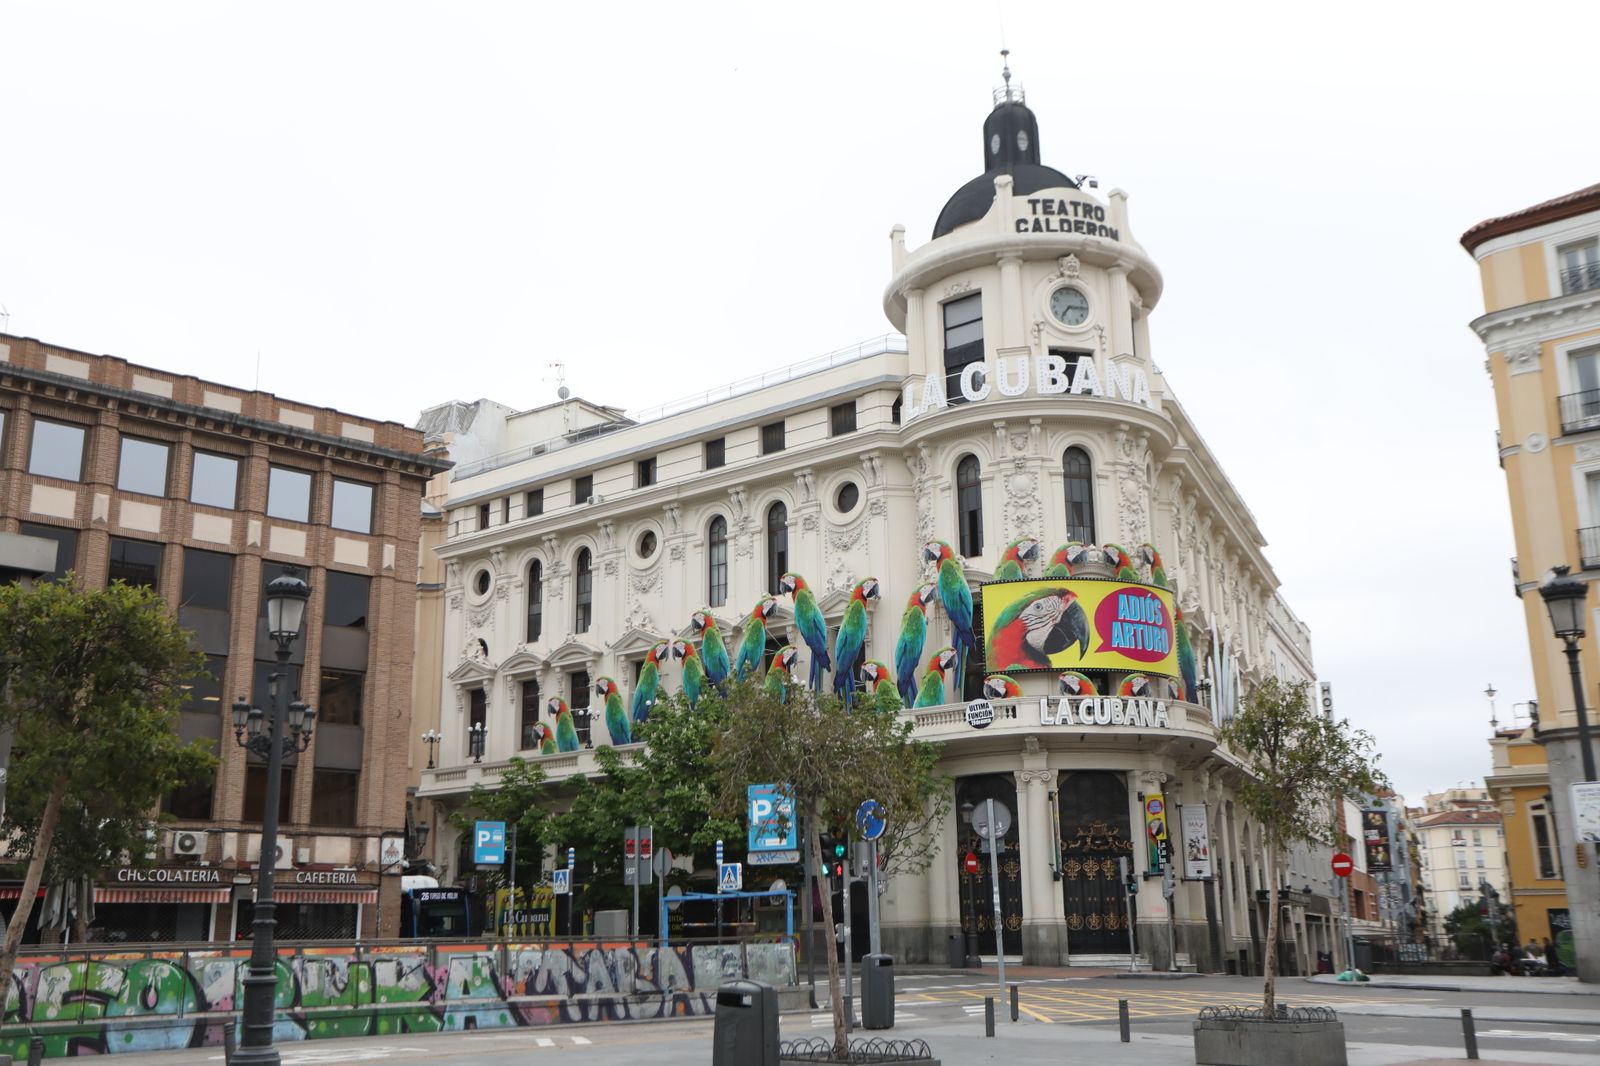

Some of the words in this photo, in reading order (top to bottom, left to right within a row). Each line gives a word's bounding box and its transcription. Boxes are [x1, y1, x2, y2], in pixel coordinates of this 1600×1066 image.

[1027, 198, 1105, 222] TEATRO
[1015, 217, 1119, 241] CALDERON
[904, 372, 949, 420] LA
[959, 353, 1151, 407] CUBANA
[1118, 593, 1162, 626] ADIÓS
[1111, 621, 1169, 654] ARTURO
[1040, 698, 1075, 726] LA
[1078, 698, 1170, 728] CUBANA
[752, 799, 772, 826] P
[478, 830, 490, 848] P
[117, 868, 220, 883] CHOCOLATERIA
[296, 871, 357, 885] CAFETERIA
[515, 910, 550, 924] Cuana
